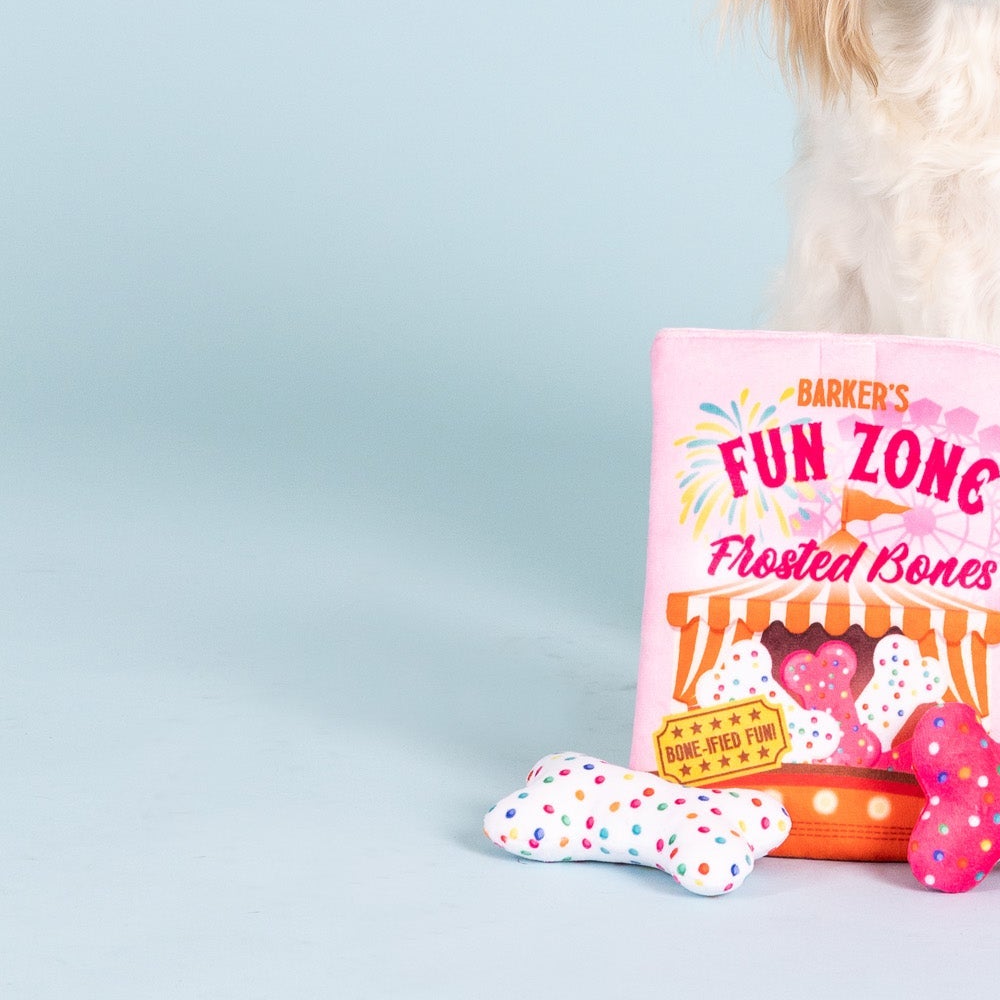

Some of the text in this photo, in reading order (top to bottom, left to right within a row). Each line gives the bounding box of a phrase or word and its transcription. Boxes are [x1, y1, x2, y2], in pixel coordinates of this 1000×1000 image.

[797, 378, 909, 411] BARKER'S
[718, 422, 1000, 514] FUN ZONE
[708, 535, 997, 589] Frosted Bones
[665, 723, 777, 763] BONE-IFIED FUN!
